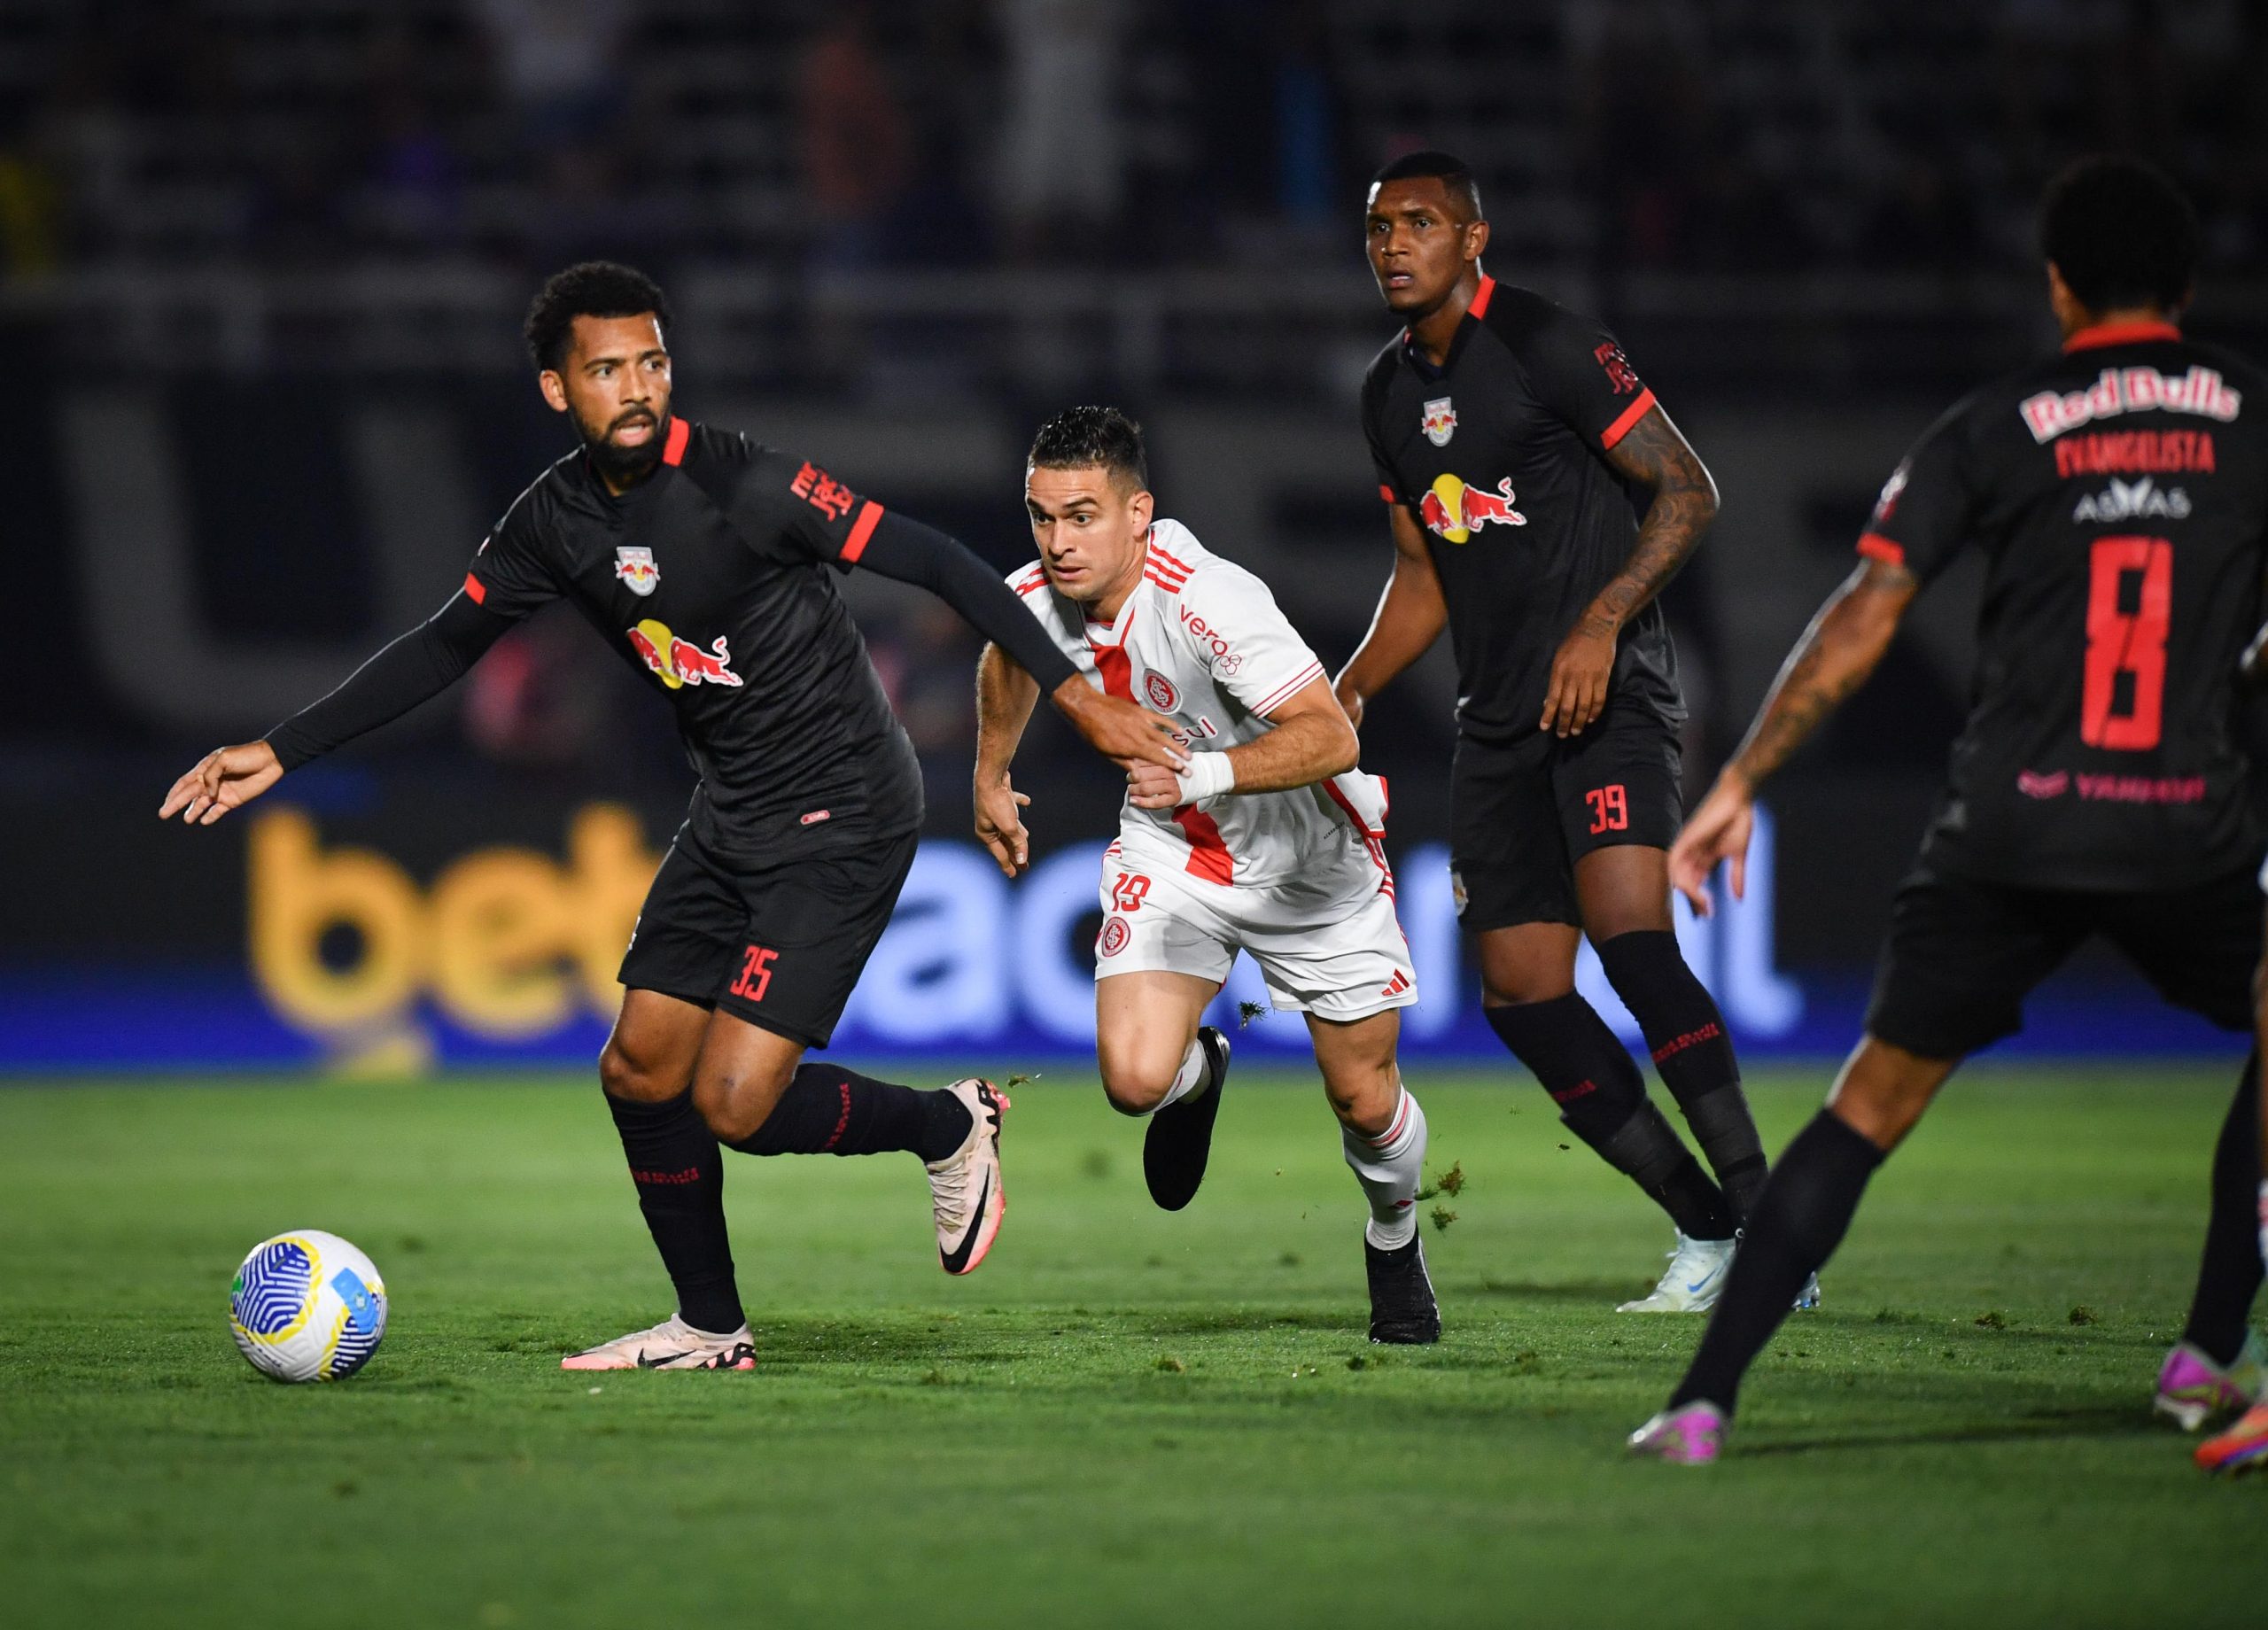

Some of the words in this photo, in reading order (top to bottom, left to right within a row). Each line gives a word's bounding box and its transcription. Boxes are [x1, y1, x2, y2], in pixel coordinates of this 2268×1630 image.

[2022, 369, 2123, 442] Red
[2124, 366, 2241, 423] Bulls
[1181, 603, 1228, 656] vero
[2079, 535, 2173, 750] 8
[1585, 784, 1628, 834] 39
[1112, 872, 1152, 912] 19
[729, 944, 780, 1002] 35
